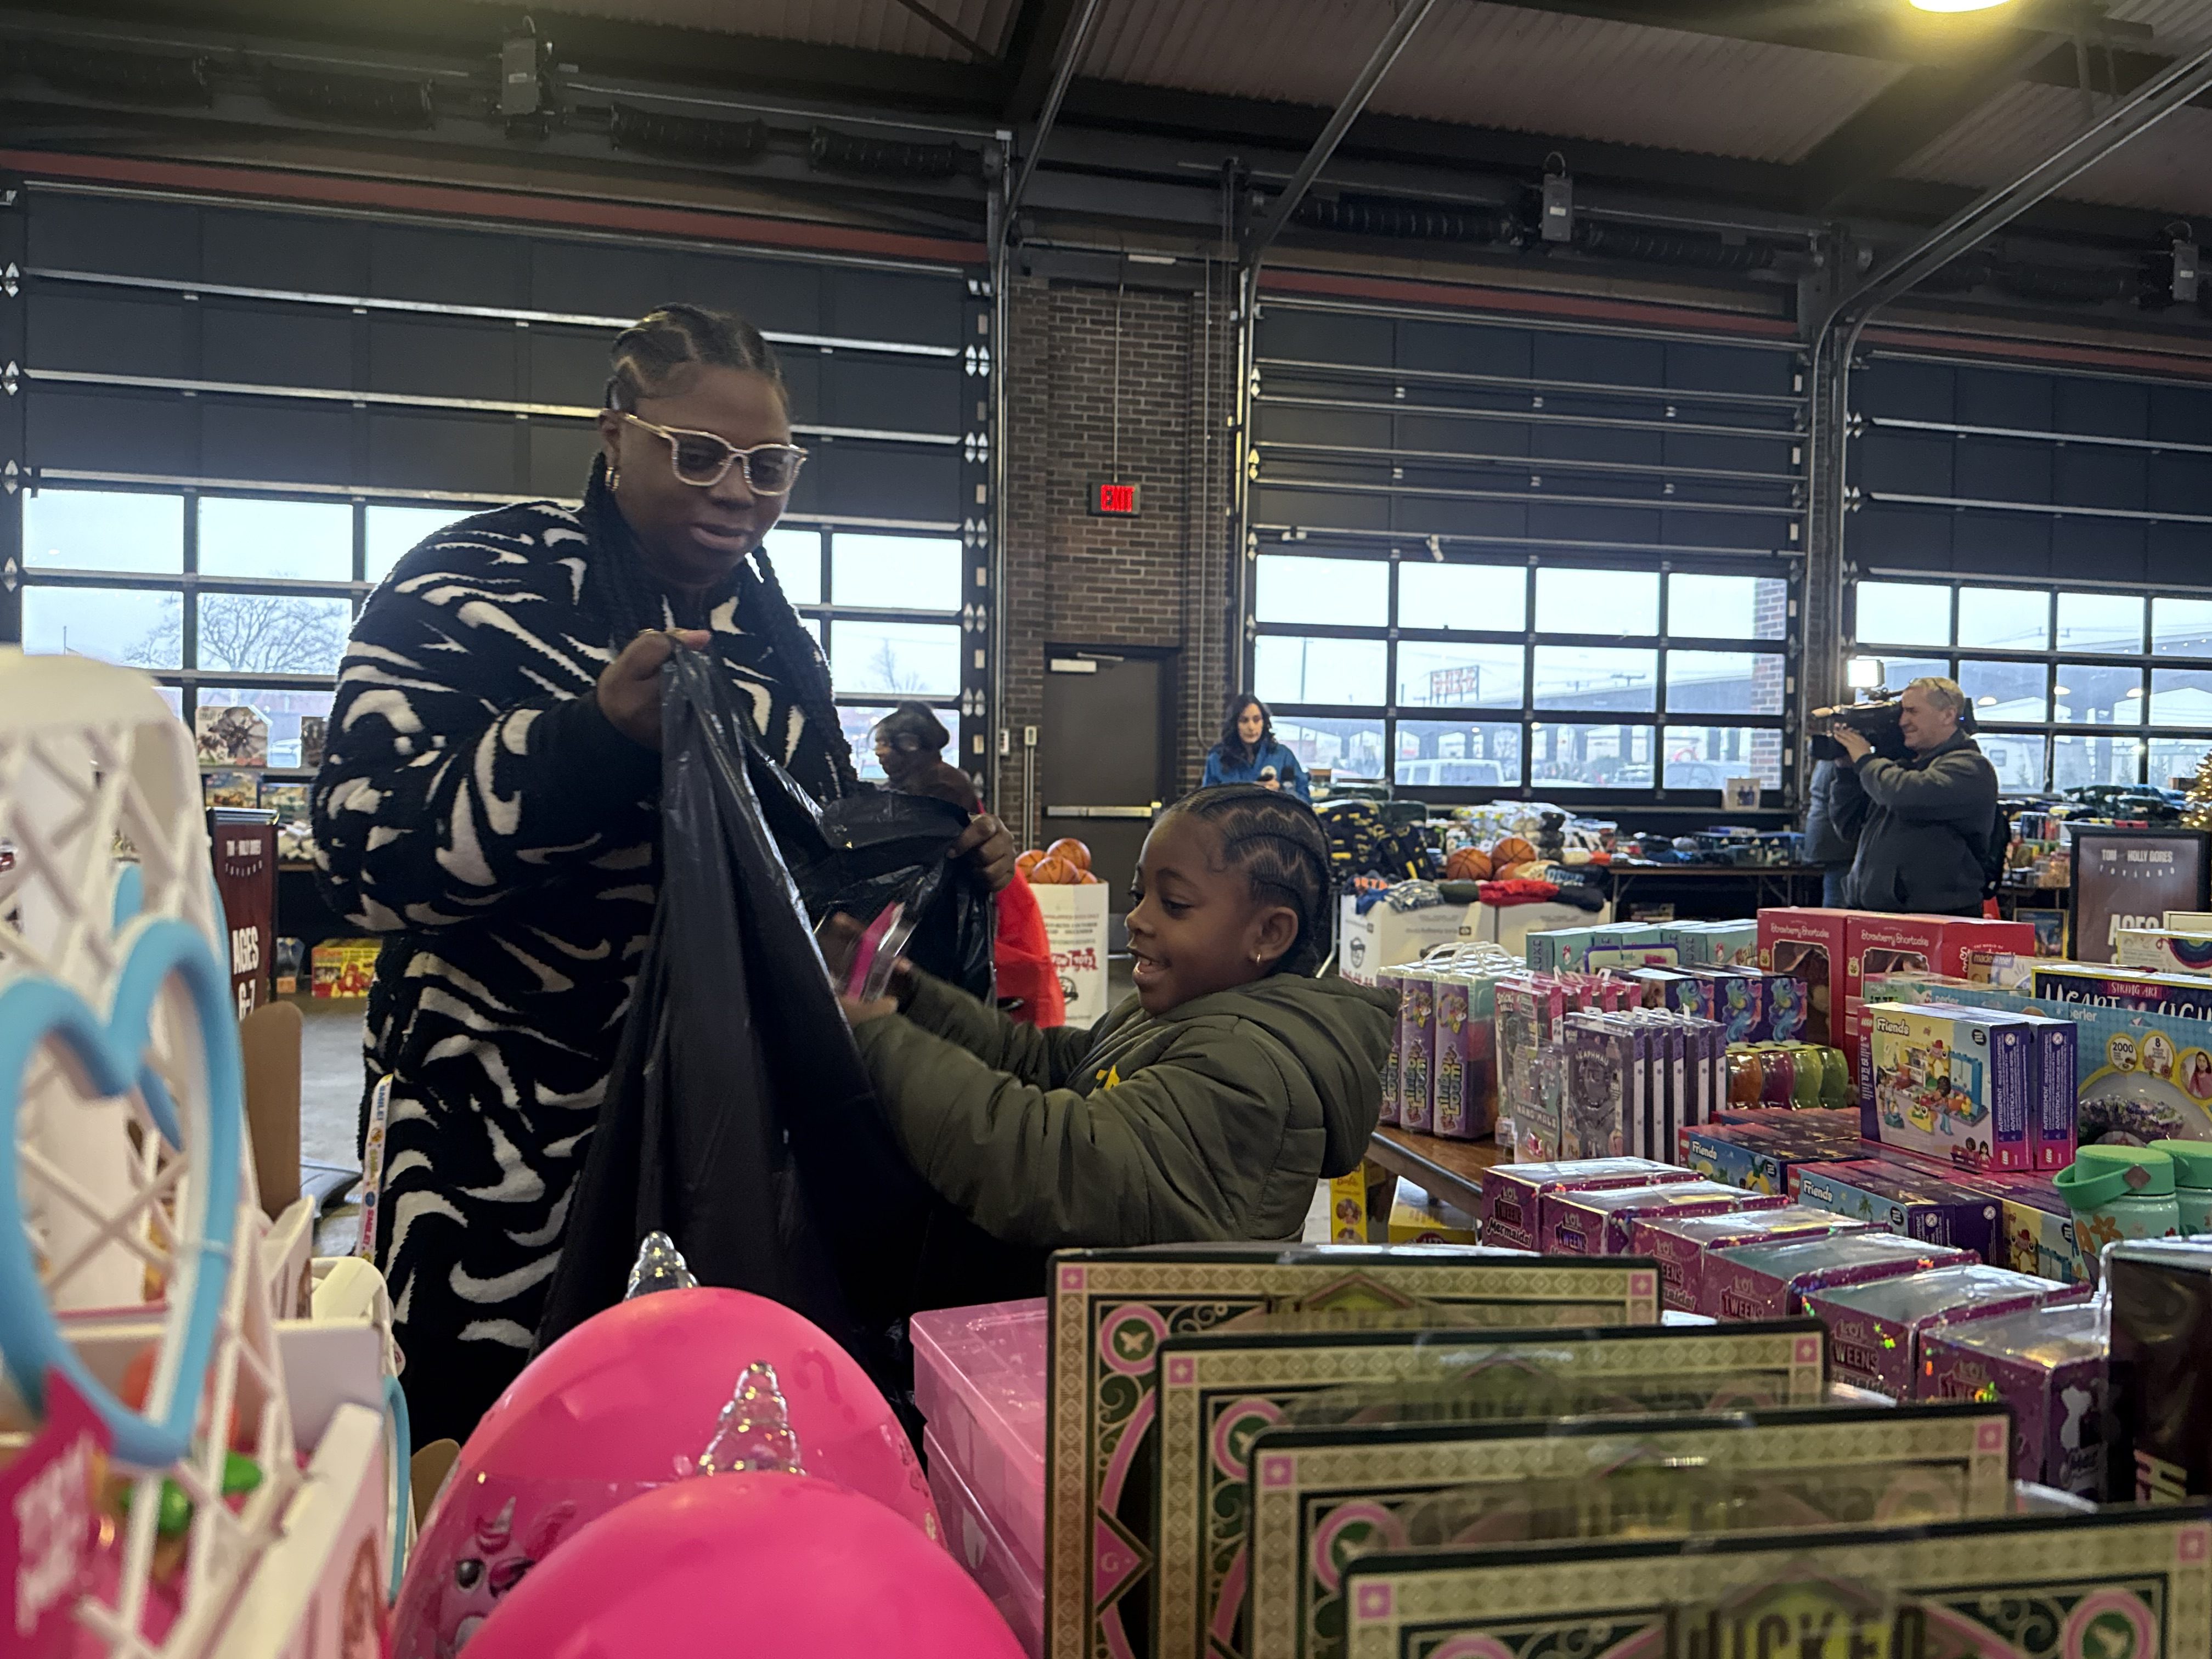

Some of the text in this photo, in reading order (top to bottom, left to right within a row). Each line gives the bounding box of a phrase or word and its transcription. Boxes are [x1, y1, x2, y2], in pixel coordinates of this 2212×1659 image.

[233, 926, 259, 975] AGES
[2111, 982, 2140, 996] STRING
[1876, 1017, 1910, 1036] Friends
[2112, 1041, 2134, 1053] 2000
[2155, 1037, 2161, 1048] 8
[1437, 1045, 1458, 1130] Rainbow
[1450, 1063, 1463, 1116] Loom
[1692, 1139, 1718, 1161] Friends
[1803, 1178, 1833, 1205] Friends
[363, 1209, 375, 1245] SMILE!
[1487, 1217, 1532, 1248] Mermaids!
[1834, 1343, 1880, 1374] WEENS
